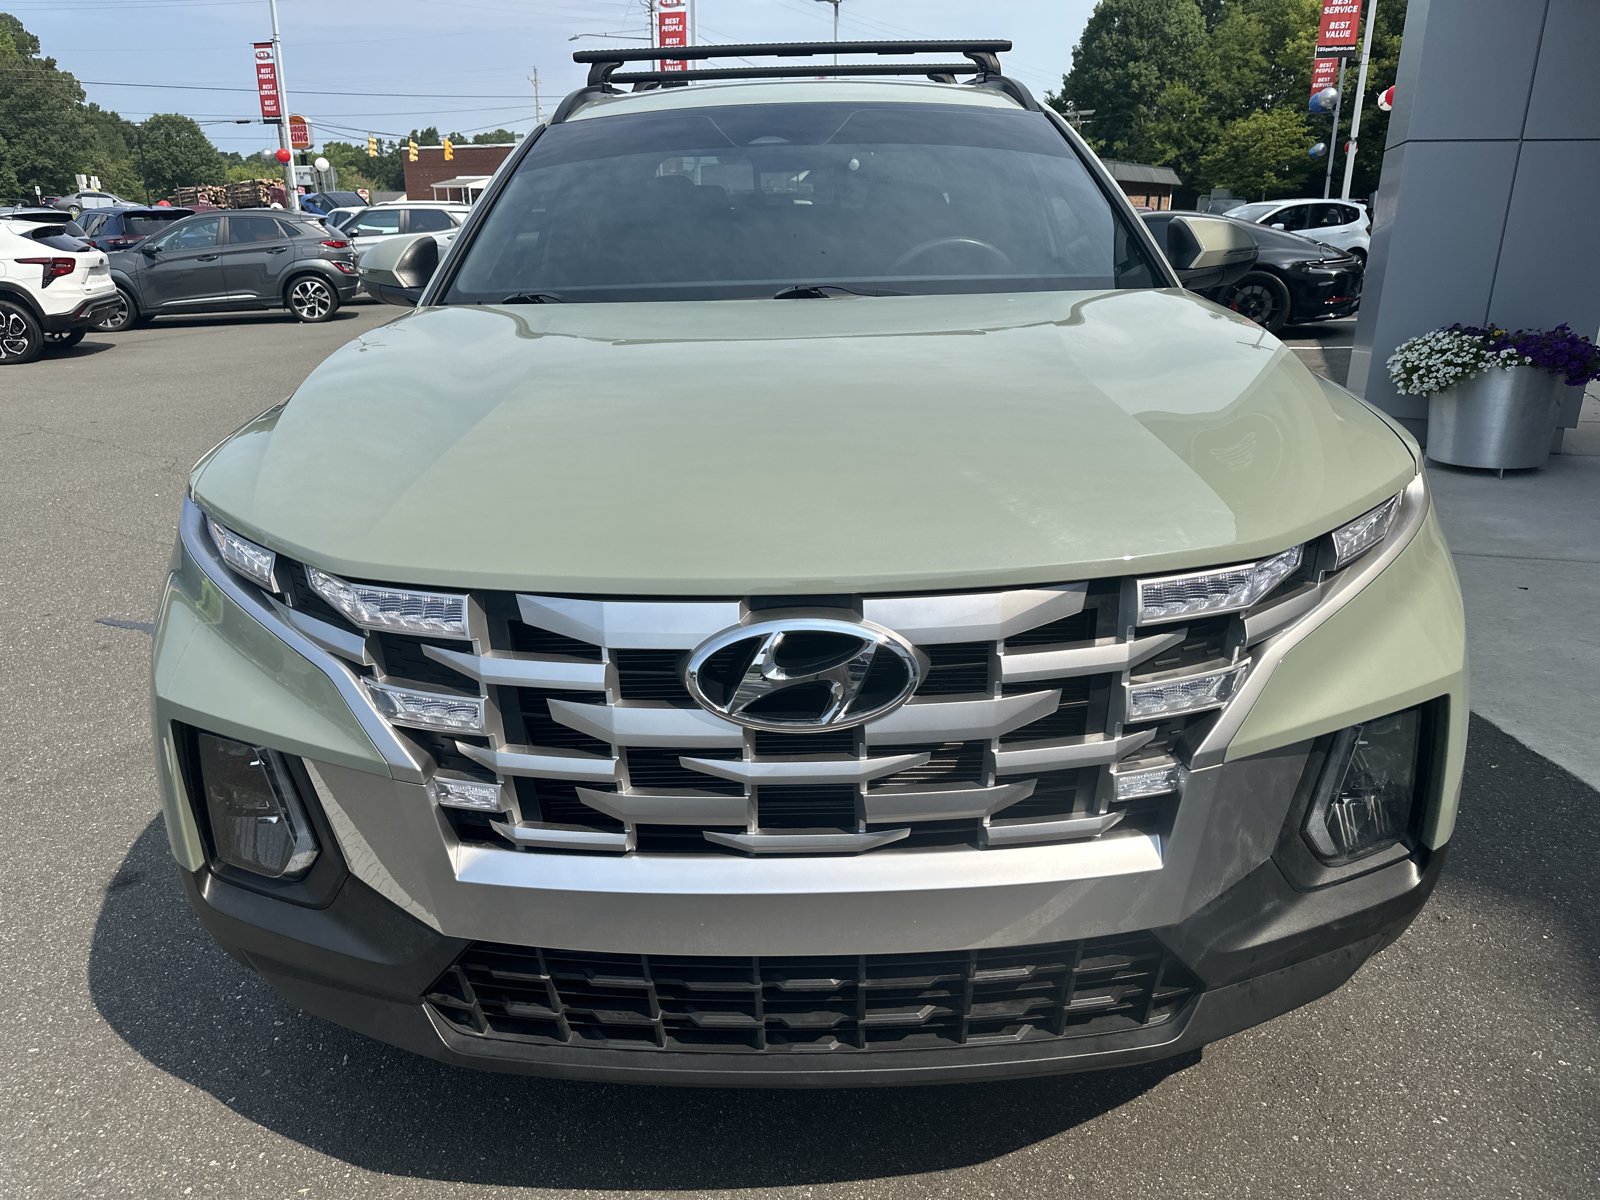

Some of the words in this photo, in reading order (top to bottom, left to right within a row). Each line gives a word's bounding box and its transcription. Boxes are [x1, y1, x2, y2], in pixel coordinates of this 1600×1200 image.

[1324, 5, 1358, 14] SERVICE
[1329, 21, 1350, 30] BEST
[1325, 30, 1351, 39] VALUE
